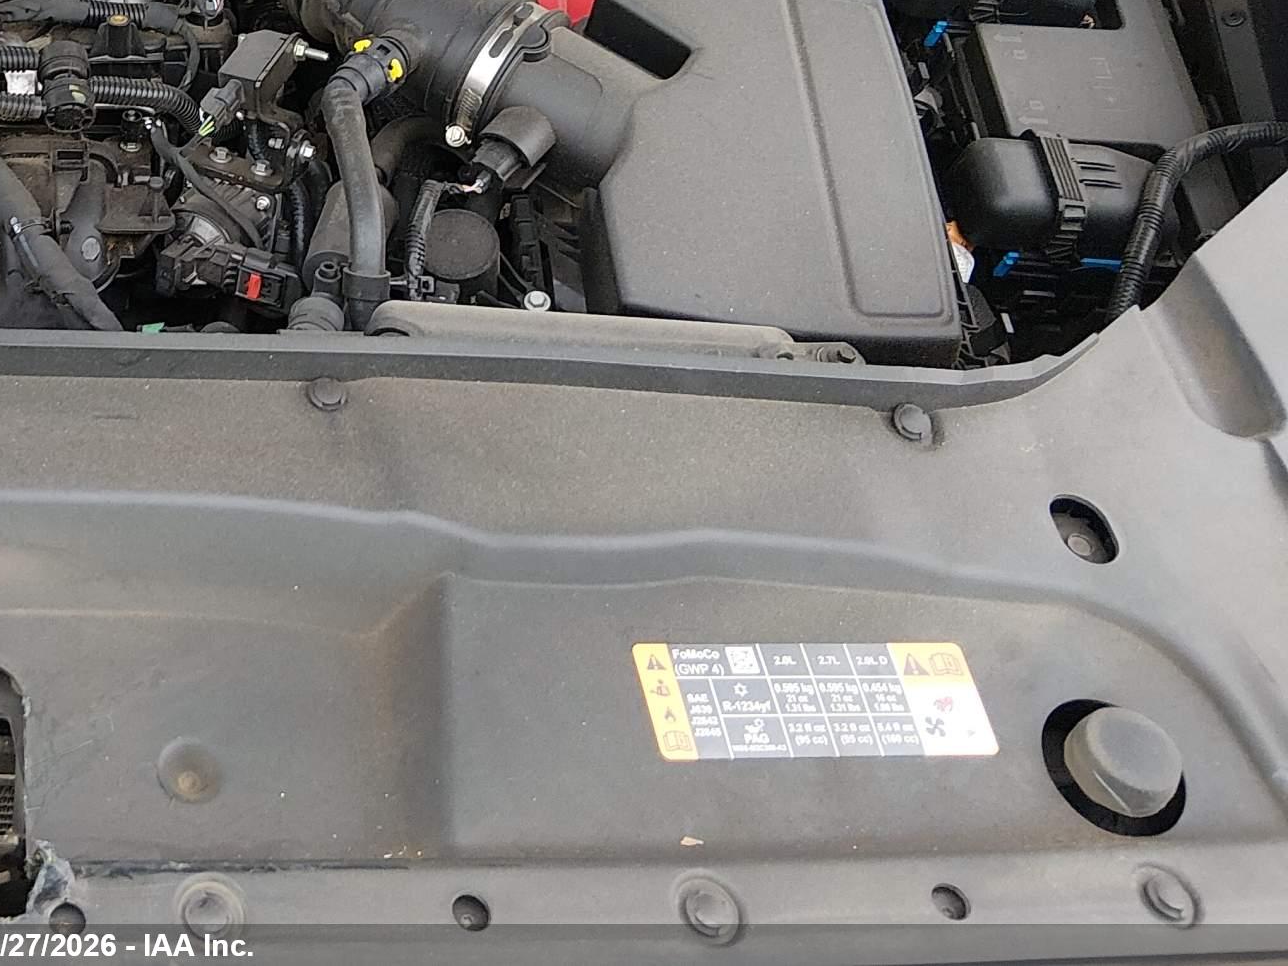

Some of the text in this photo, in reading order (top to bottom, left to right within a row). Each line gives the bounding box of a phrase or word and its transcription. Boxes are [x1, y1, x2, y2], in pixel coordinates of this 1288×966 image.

[671, 648, 721, 660] FoMoCo
[674, 663, 709, 677] (GWP
[721, 699, 771, 714] R-1234yf
[743, 733, 770, 745] PAG
